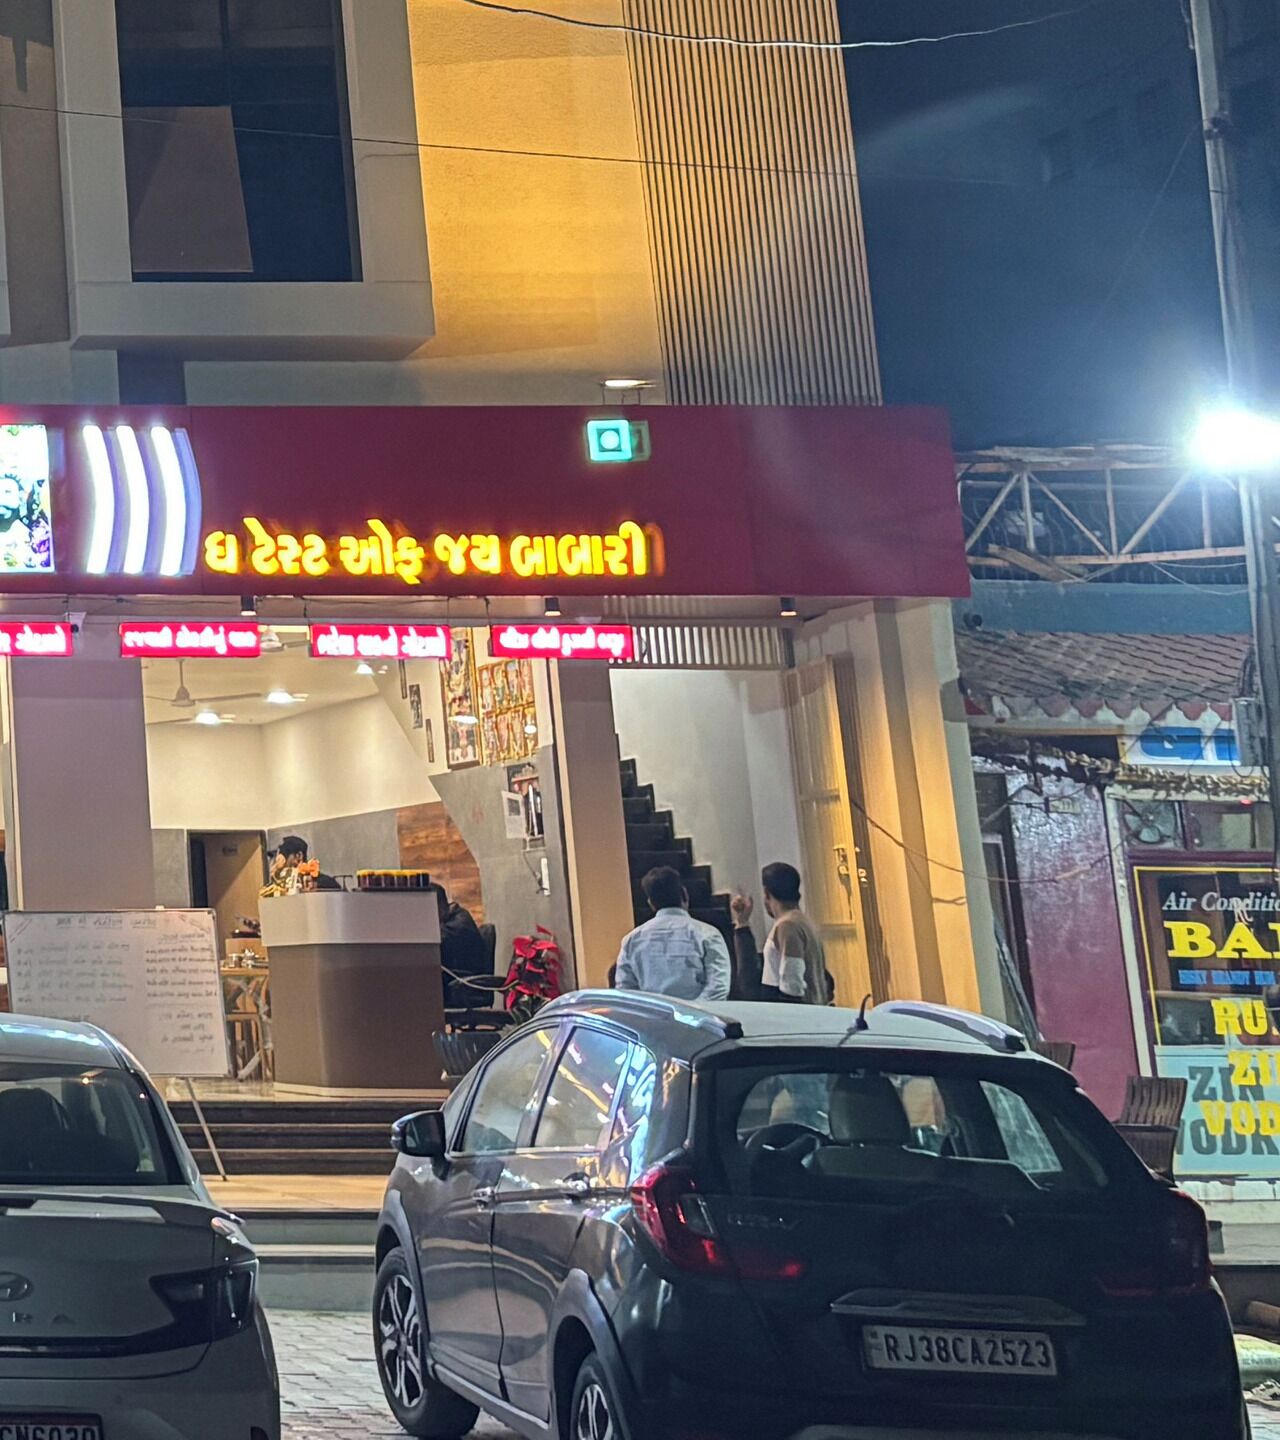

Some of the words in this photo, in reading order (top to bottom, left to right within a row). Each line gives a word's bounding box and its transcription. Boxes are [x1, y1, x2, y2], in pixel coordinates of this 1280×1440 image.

[339, 518, 425, 584] ઓફ
[434, 533, 501, 576] જય
[509, 521, 647, 577] બાબારી
[1162, 891, 1197, 911] Air
[1211, 999, 1280, 1036] RU
[1228, 1050, 1280, 1086] ZI
[884, 1334, 1051, 1367] RJ38CA2523
